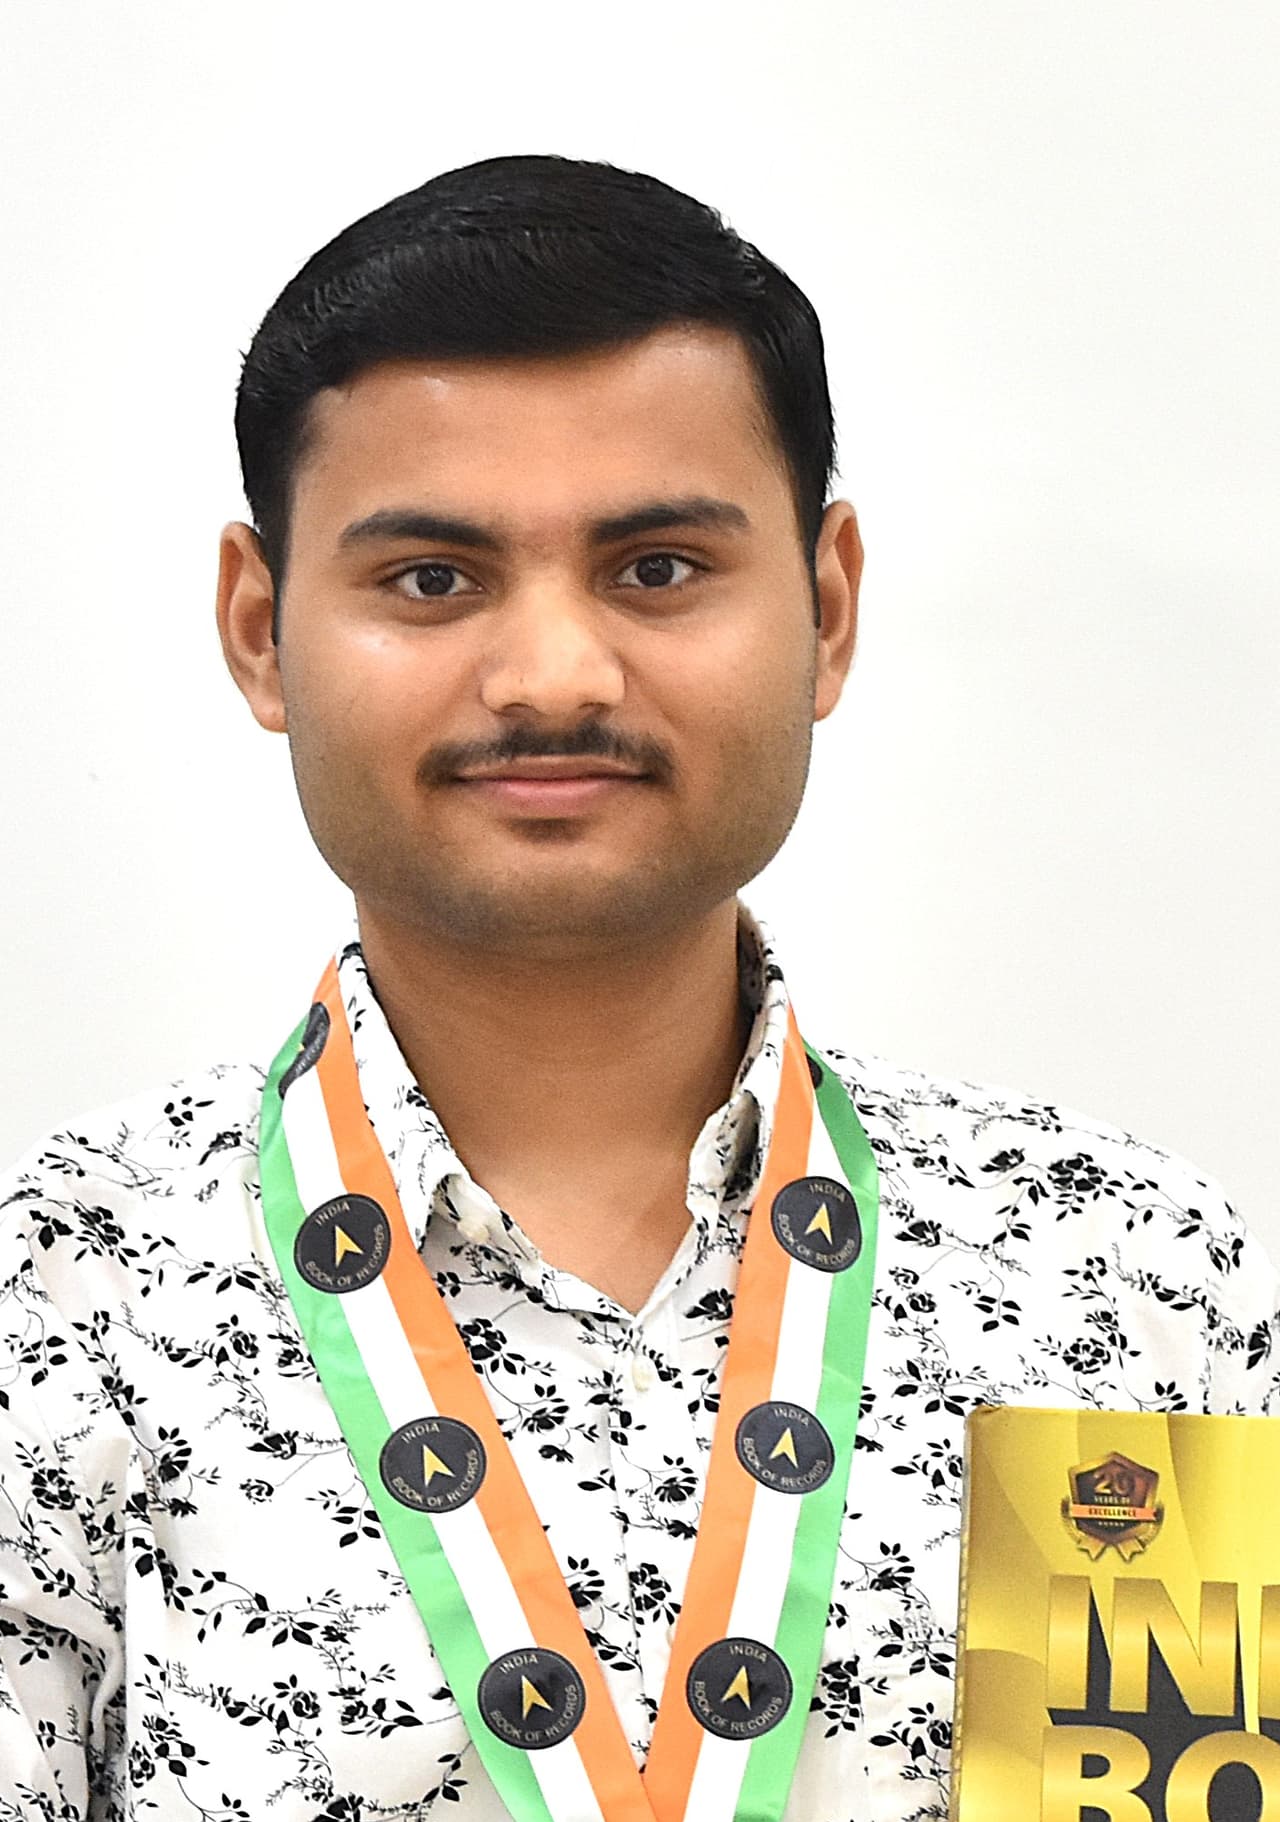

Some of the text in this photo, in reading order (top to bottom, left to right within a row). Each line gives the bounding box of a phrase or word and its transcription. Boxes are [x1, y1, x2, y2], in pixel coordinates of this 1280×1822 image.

[809, 1183, 846, 1203] INDIA
[315, 1201, 350, 1227] INDIA
[778, 1213, 796, 1247] BOOK
[816, 1240, 856, 1264] RECORDS
[305, 1260, 333, 1286] BOOK
[337, 1274, 353, 1286] OF
[773, 1407, 809, 1426] INDIA
[400, 1422, 440, 1444] INDIA
[743, 1437, 826, 1487] BOOK OF RECORDS
[392, 1476, 423, 1504] BOOK
[427, 1496, 444, 1506] OF
[1089, 1508, 1137, 1517] EXCELLENCE
[499, 1654, 538, 1674] INDIA
[729, 1645, 768, 1663] INDIA
[490, 1684, 577, 1742] BOOK OF RECORDS
[695, 1681, 783, 1732] BOOK OF RECORDS
